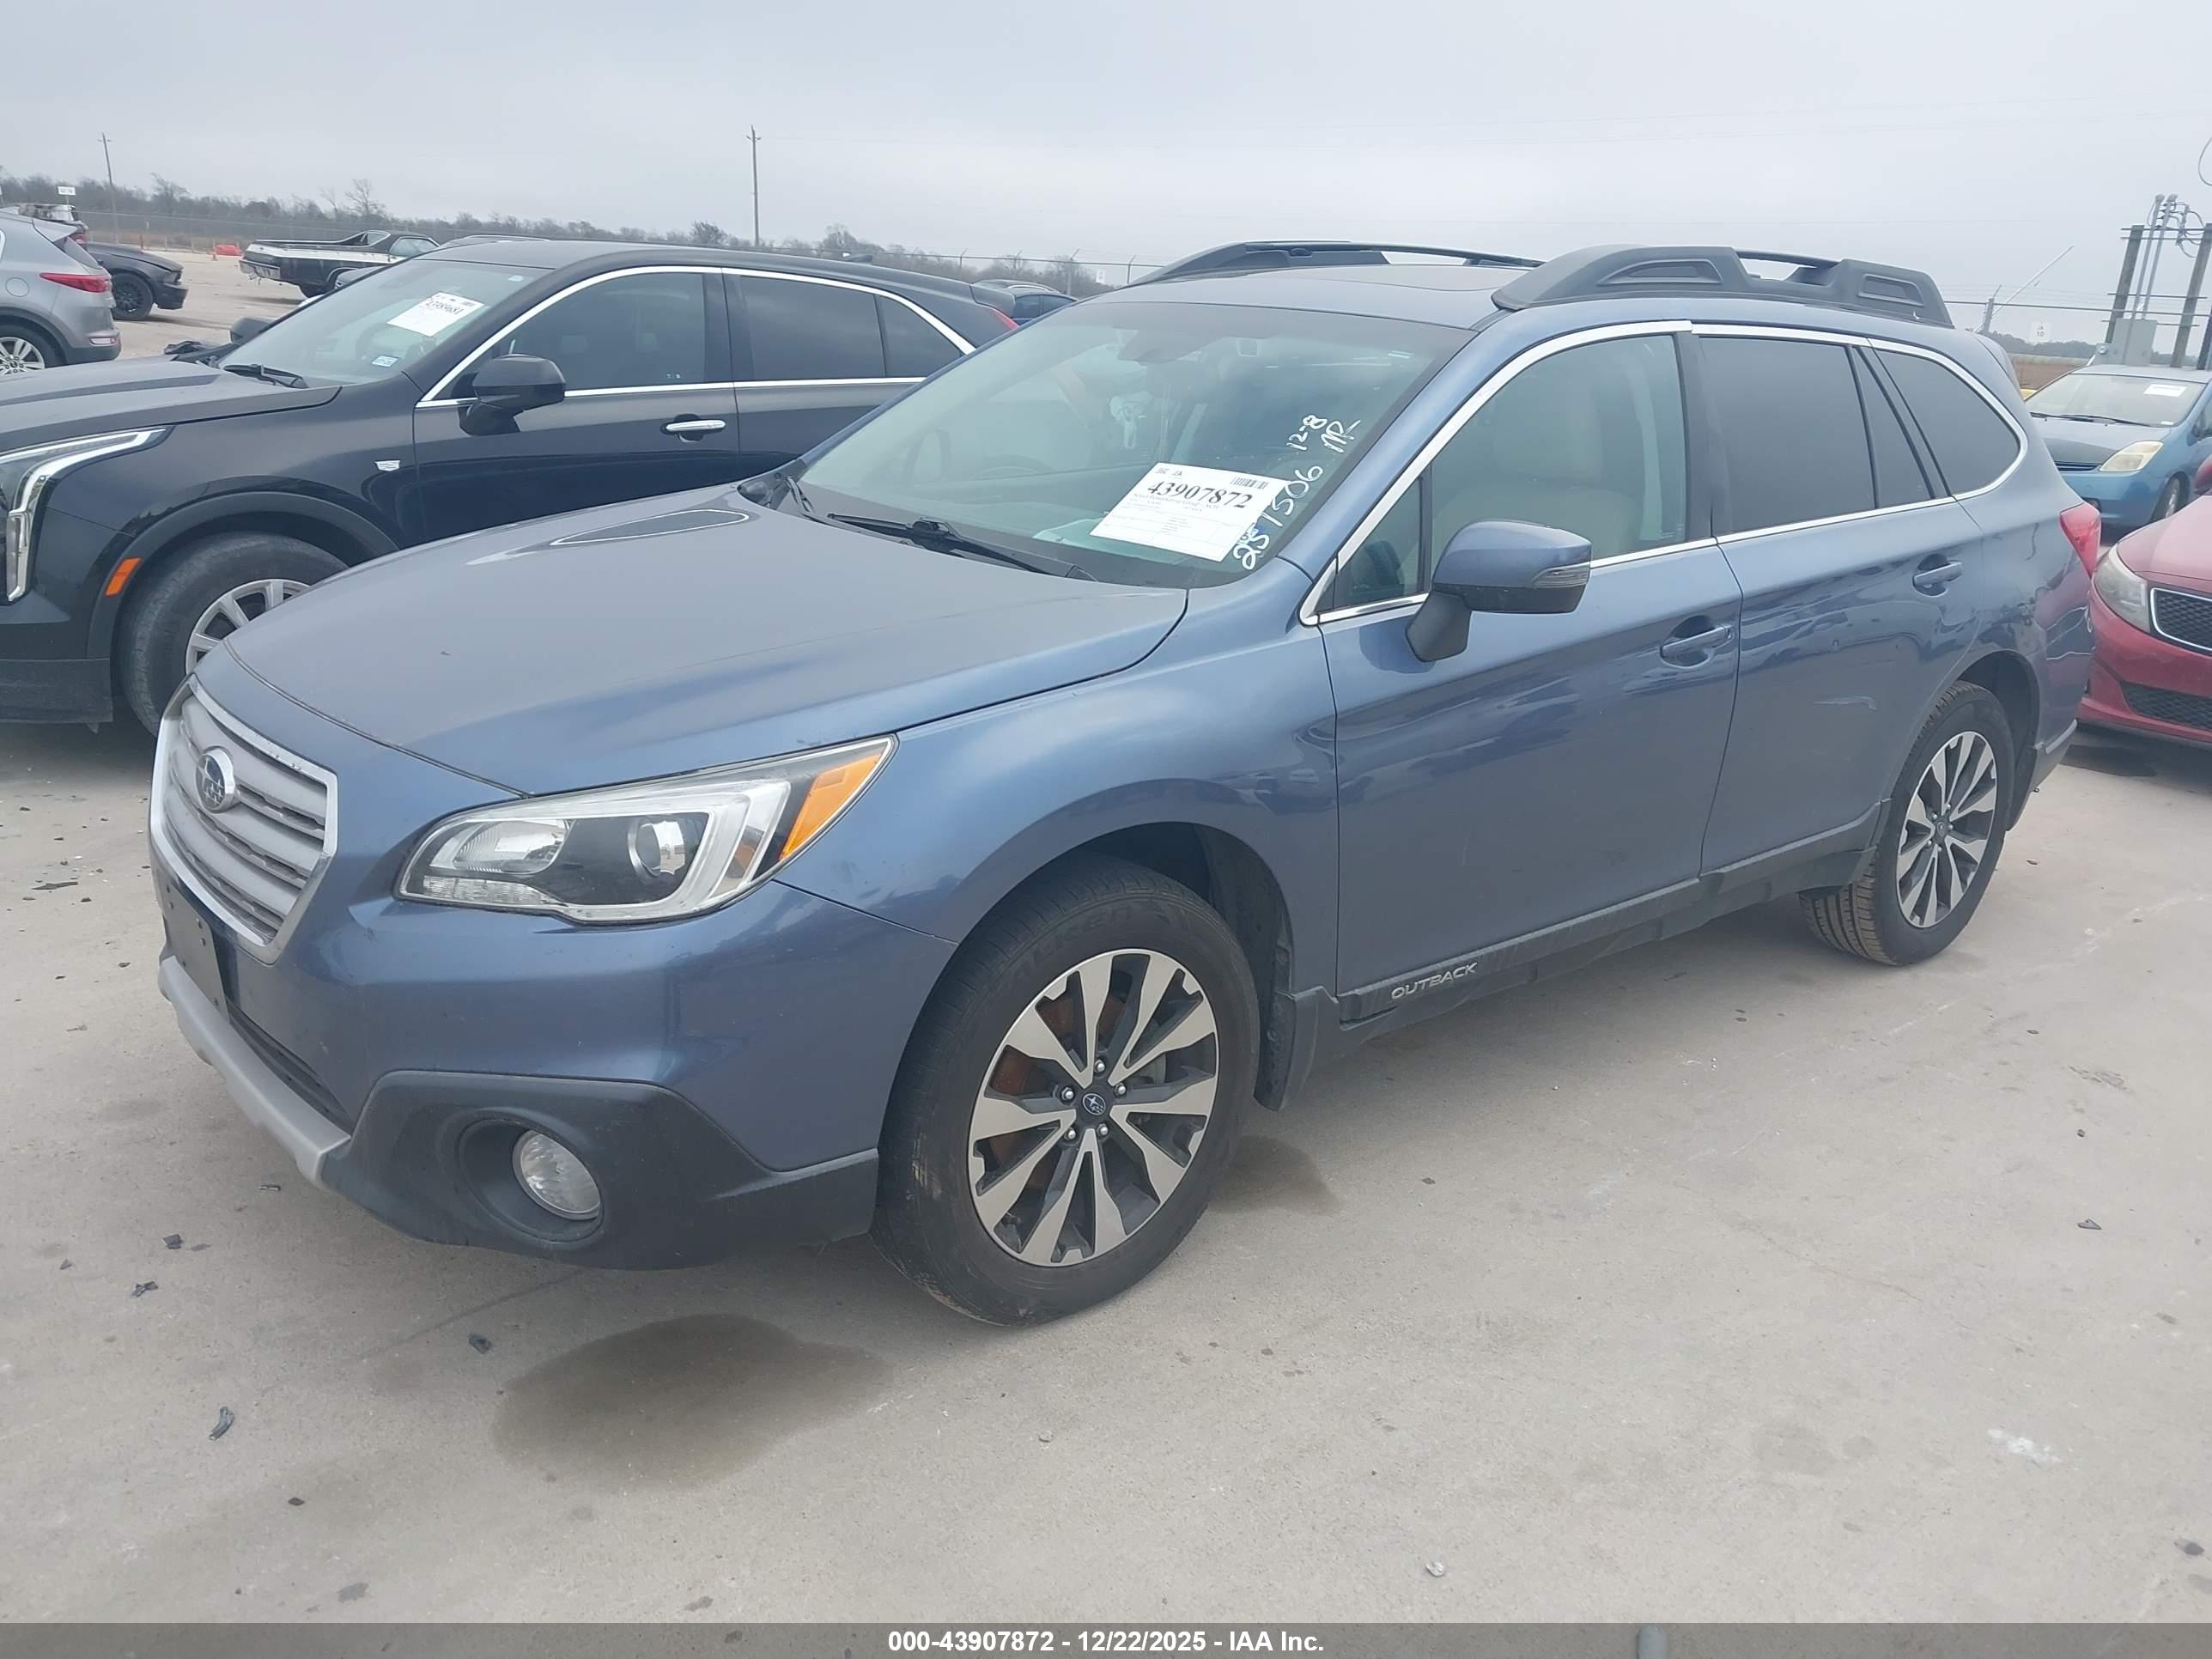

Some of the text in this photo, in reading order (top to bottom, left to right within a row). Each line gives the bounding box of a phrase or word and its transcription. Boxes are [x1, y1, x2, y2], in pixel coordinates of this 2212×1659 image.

[1286, 415, 1328, 451] 12-8
[1147, 481, 1253, 508] 43907872
[1392, 962, 1477, 999] OUTBACK
